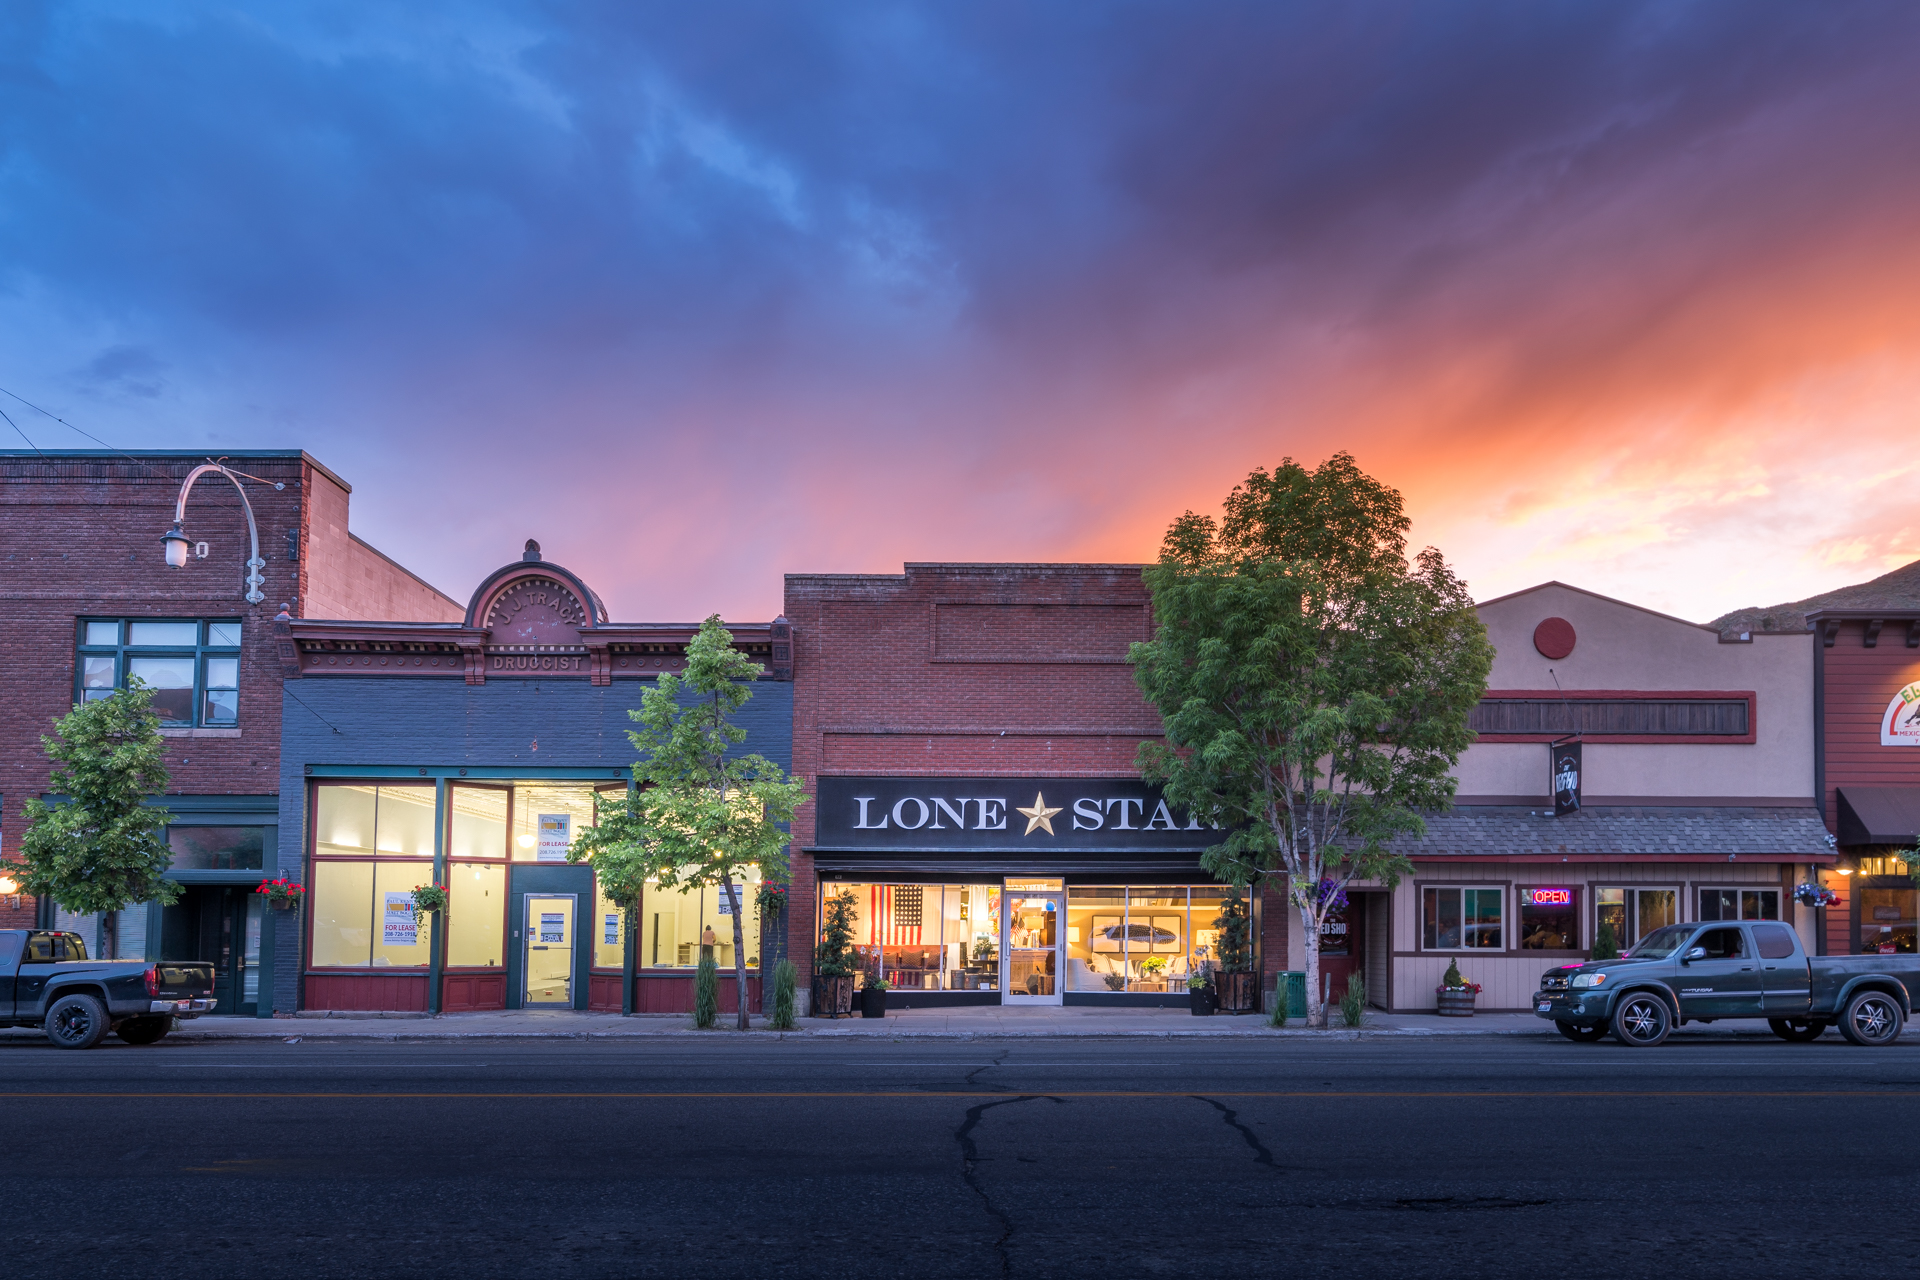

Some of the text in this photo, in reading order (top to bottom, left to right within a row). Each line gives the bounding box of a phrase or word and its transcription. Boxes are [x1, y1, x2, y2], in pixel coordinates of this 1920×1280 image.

[526, 592, 578, 624] TRACY
[493, 656, 582, 670] DRUGGIST
[853, 797, 1007, 830] LONE
[1534, 890, 1568, 903] OPEN
[1320, 922, 1350, 935] ED SHOE
